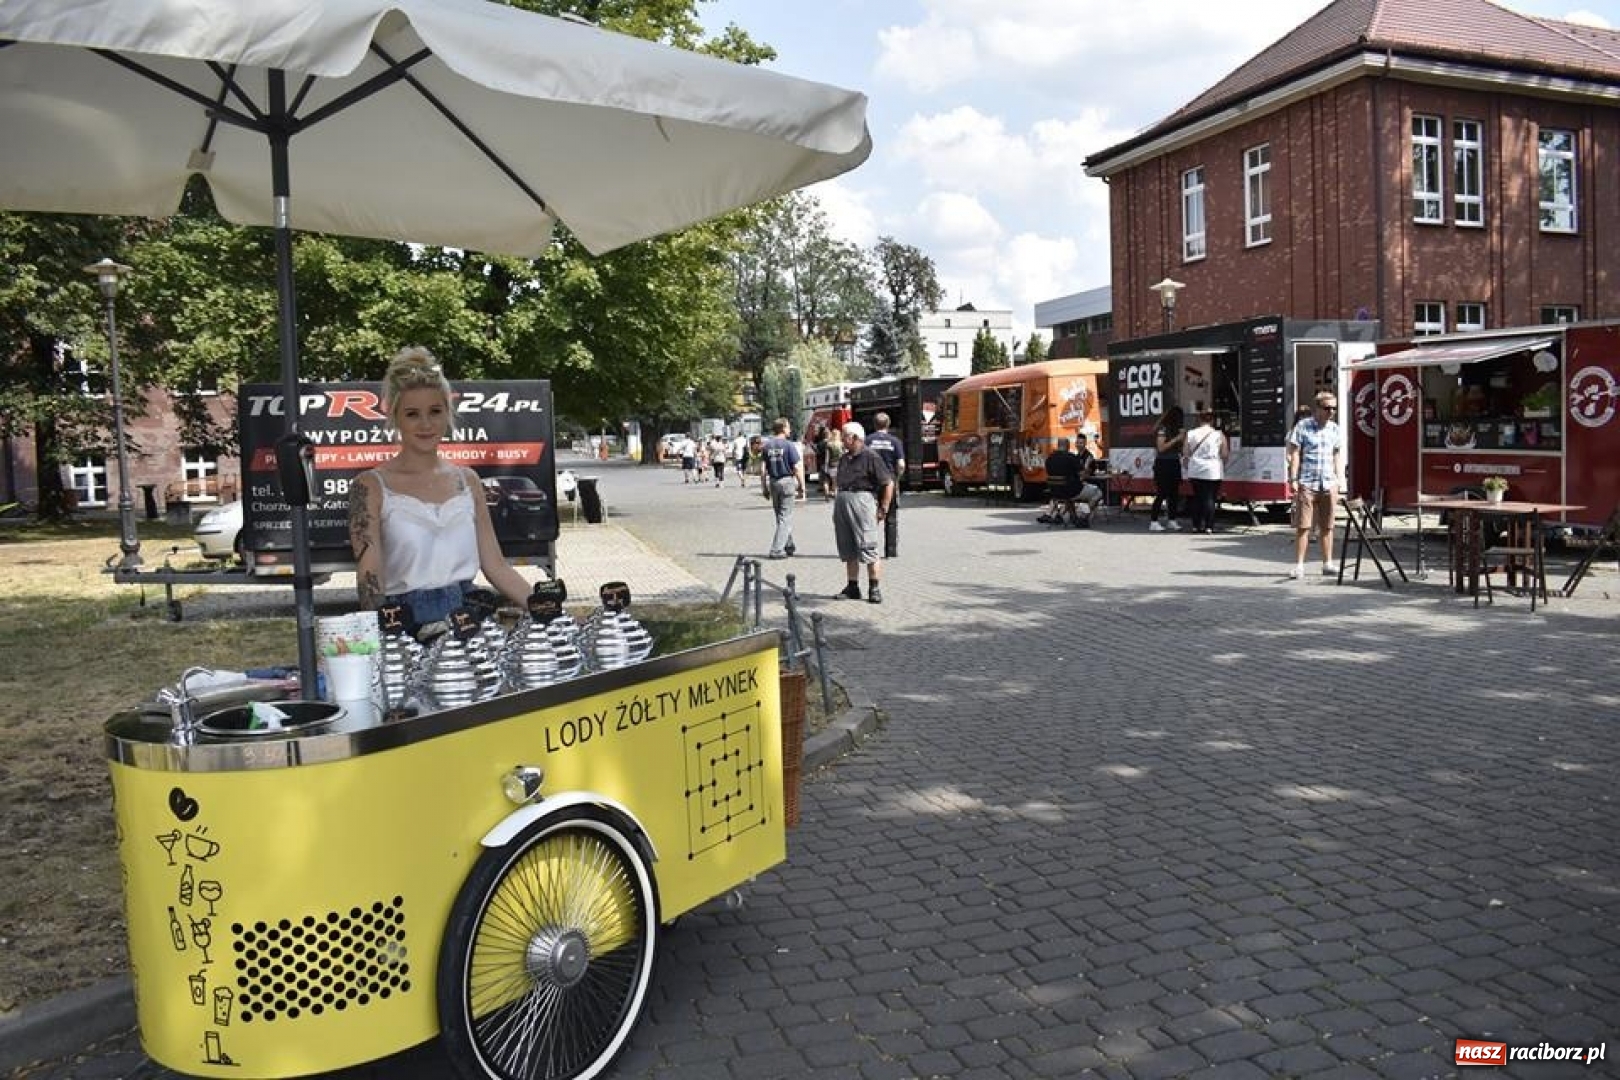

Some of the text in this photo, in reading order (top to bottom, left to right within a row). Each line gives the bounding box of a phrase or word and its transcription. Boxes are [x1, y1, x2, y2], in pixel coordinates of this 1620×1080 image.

[1119, 389, 1163, 417] uela
[497, 449, 530, 460] BUSY
[251, 478, 354, 497] tel. 98
[544, 666, 759, 753] LODY ŻÓŁTY MŁYNEK
